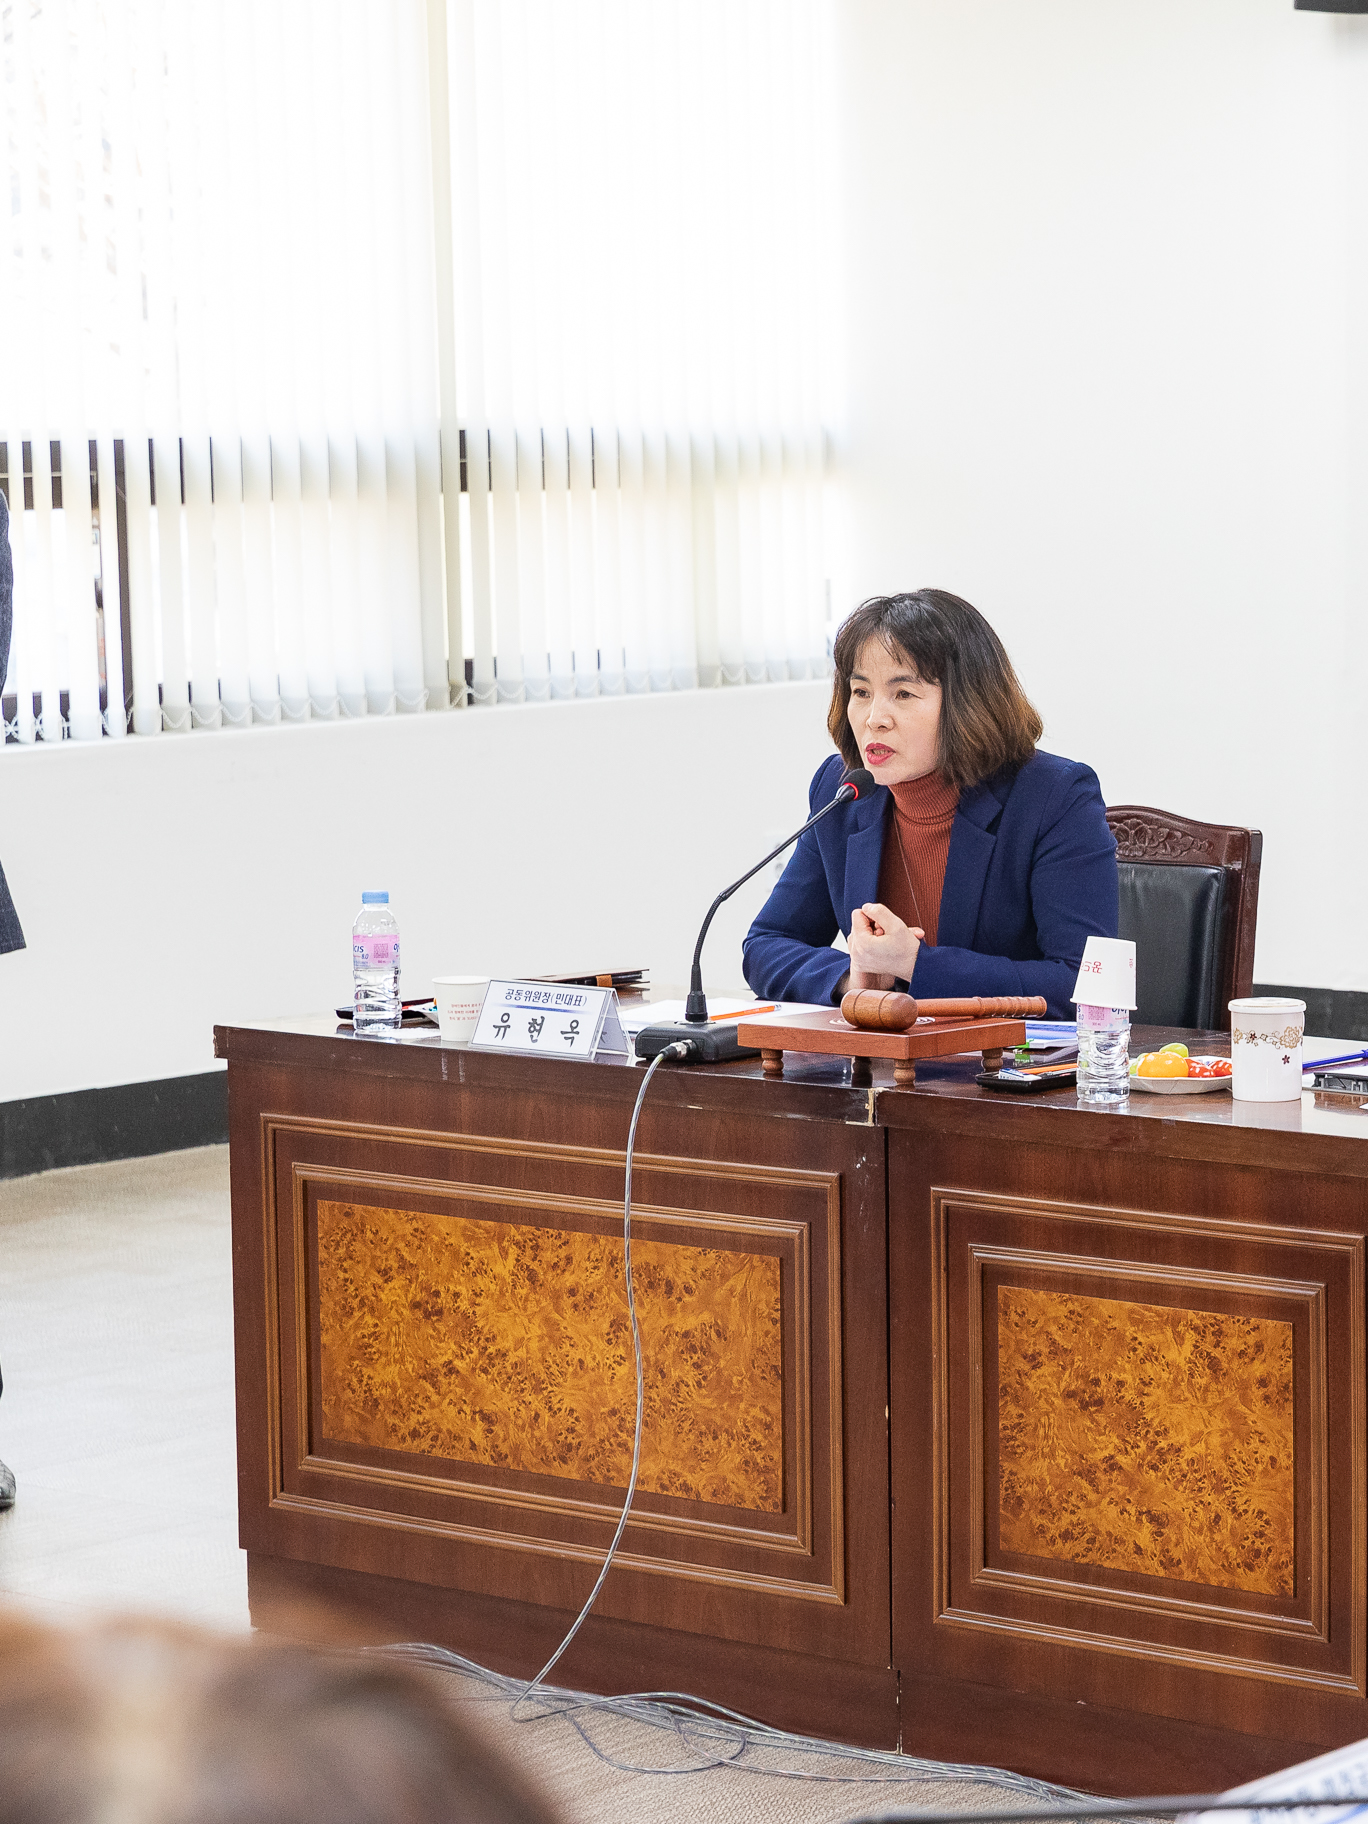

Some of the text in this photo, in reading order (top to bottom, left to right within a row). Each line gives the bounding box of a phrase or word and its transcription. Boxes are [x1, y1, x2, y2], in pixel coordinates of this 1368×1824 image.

[504, 988, 588, 1007] 공동위원장(민대표)
[492, 1012, 511, 1041] 유
[528, 1015, 546, 1044] 현
[560, 1019, 580, 1048] 옥
